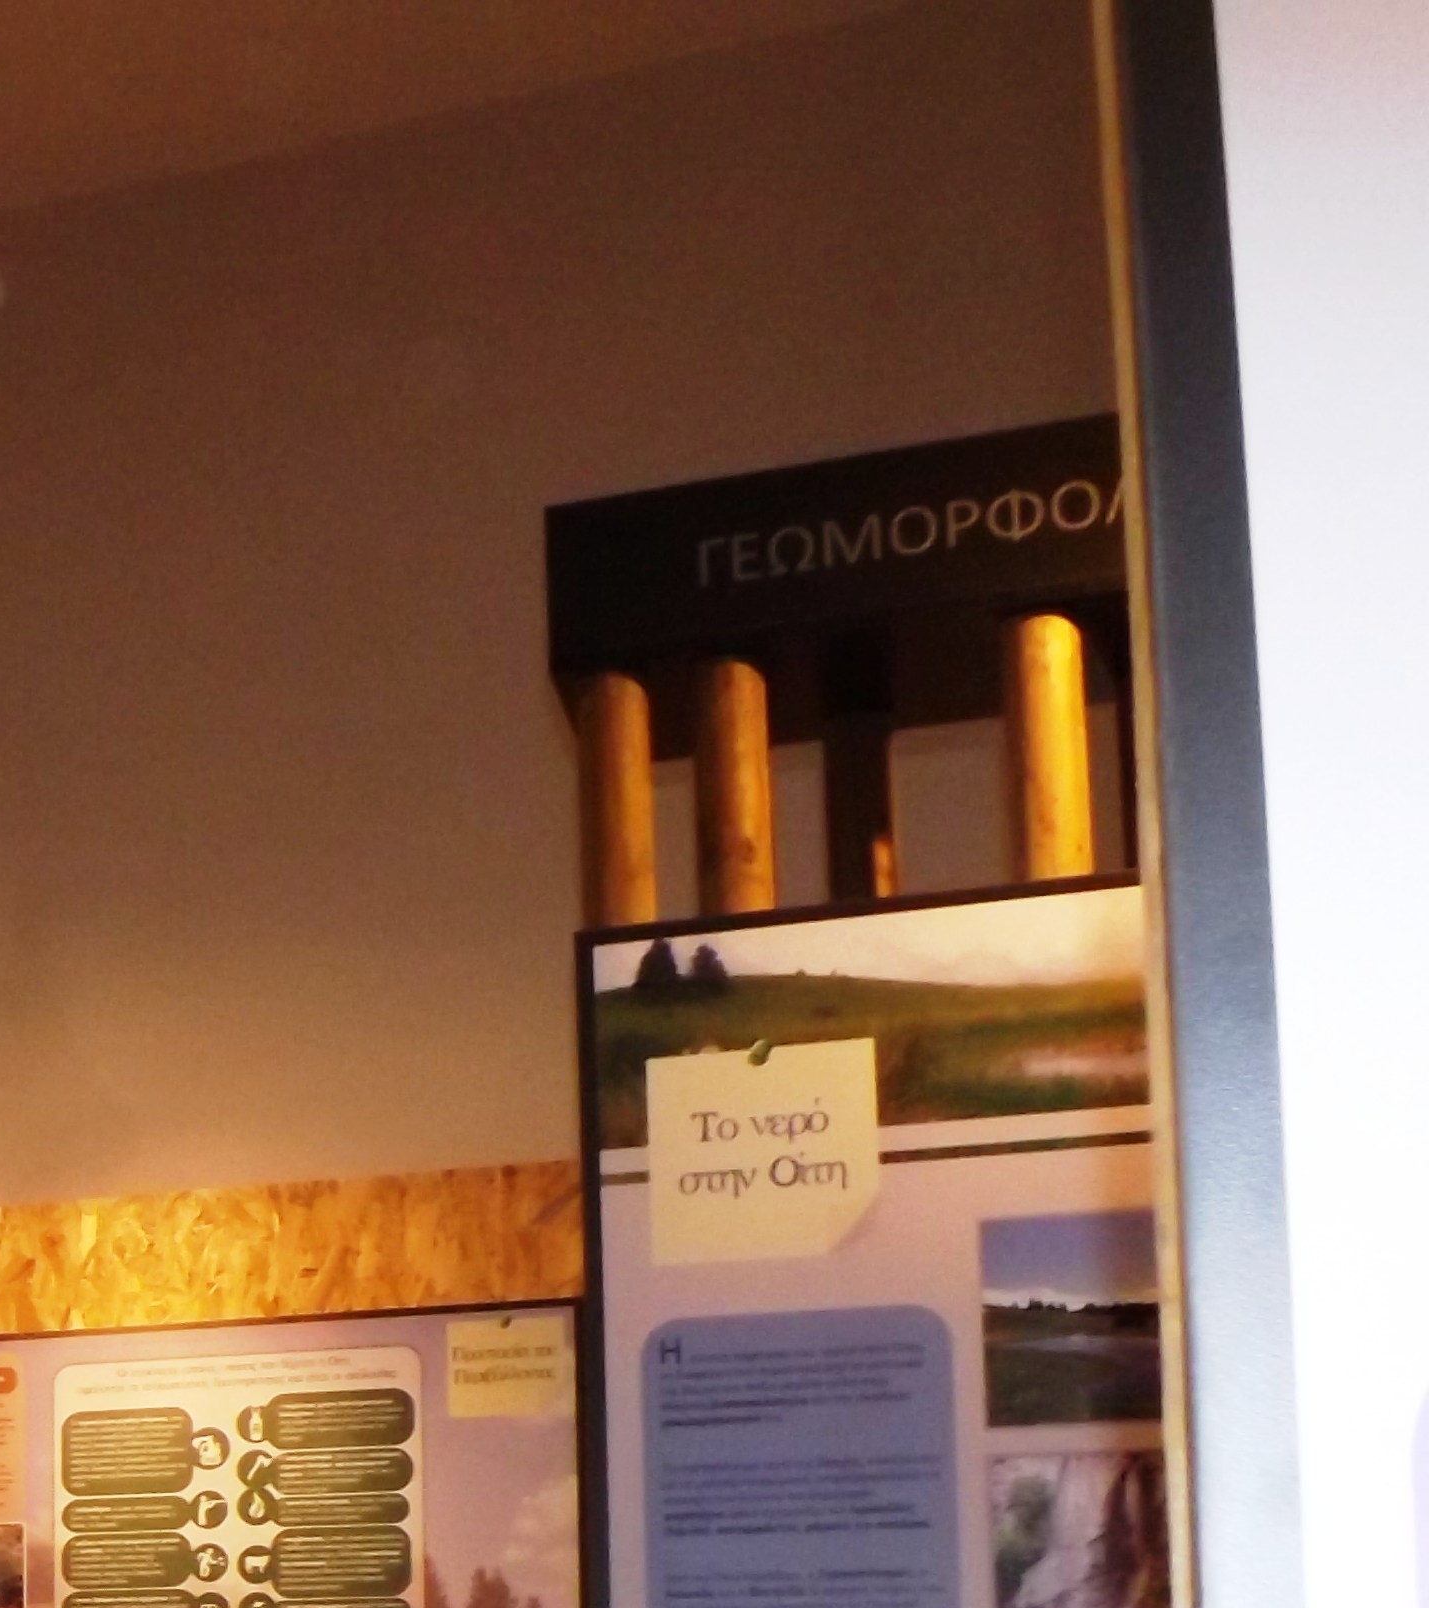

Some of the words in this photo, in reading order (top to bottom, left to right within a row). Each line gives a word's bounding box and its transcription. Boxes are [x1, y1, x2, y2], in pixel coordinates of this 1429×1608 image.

[690, 1110, 739, 1142] Το
[749, 1097, 830, 1144] νερό
[678, 1166, 758, 1199] στην
[769, 1152, 848, 1190] Οίτη
